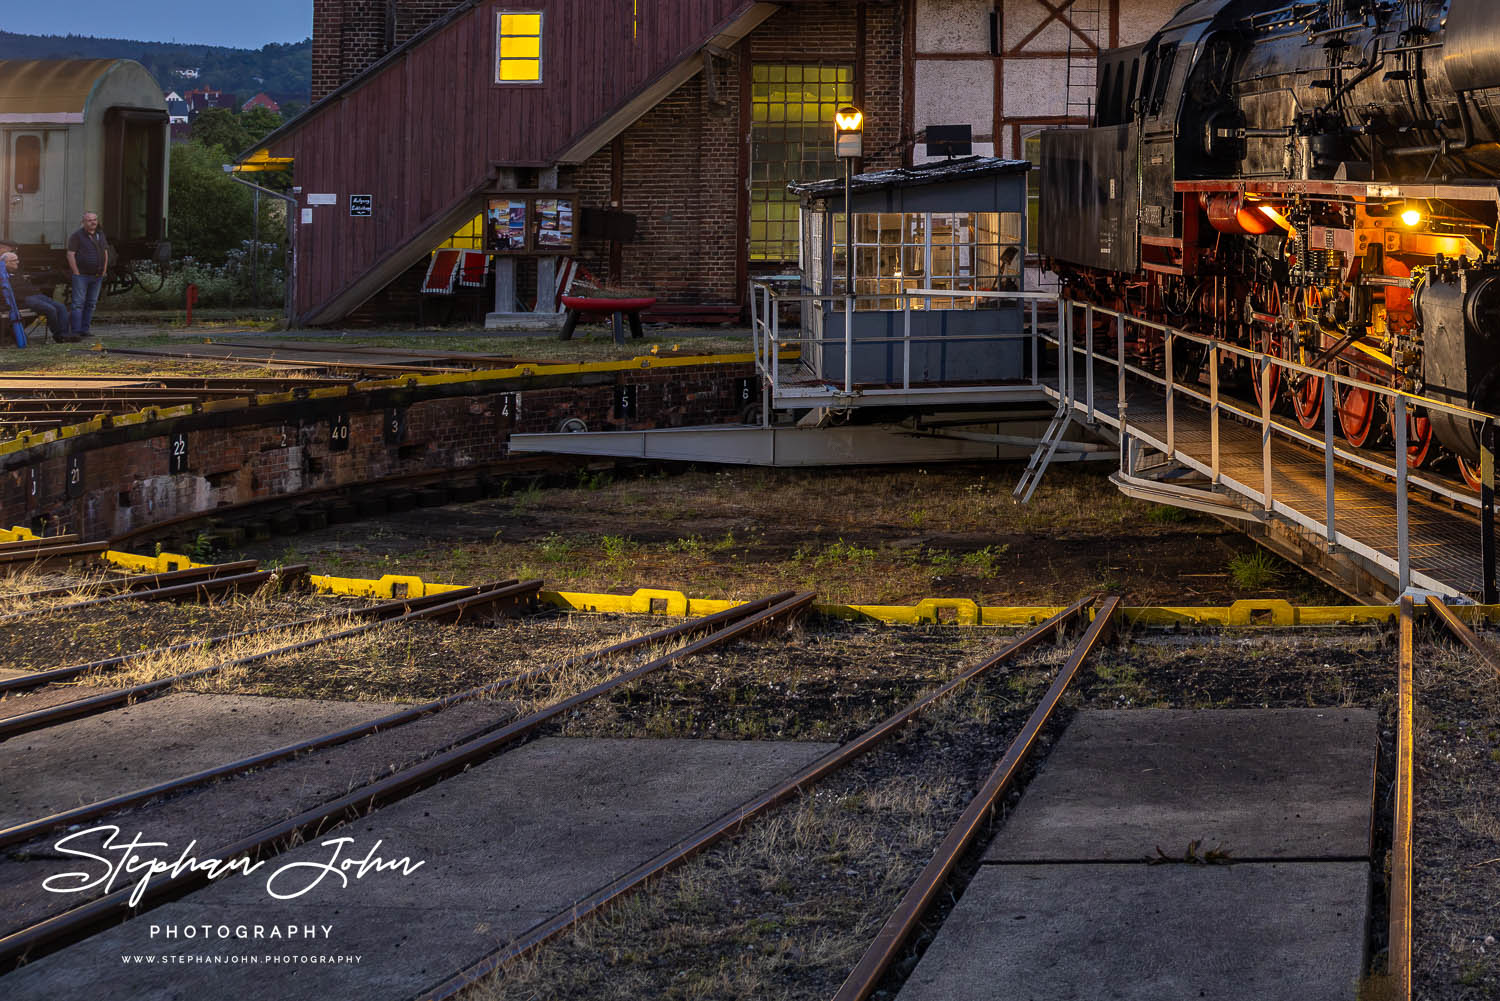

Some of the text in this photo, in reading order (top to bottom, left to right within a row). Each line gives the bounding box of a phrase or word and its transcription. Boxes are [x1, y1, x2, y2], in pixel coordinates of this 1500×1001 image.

[742, 388, 749, 400] 6
[621, 396, 629, 408] 5
[501, 404, 509, 417] 4
[392, 420, 399, 433] 3
[280, 433, 287, 448] 2
[173, 441, 185, 456] 22
